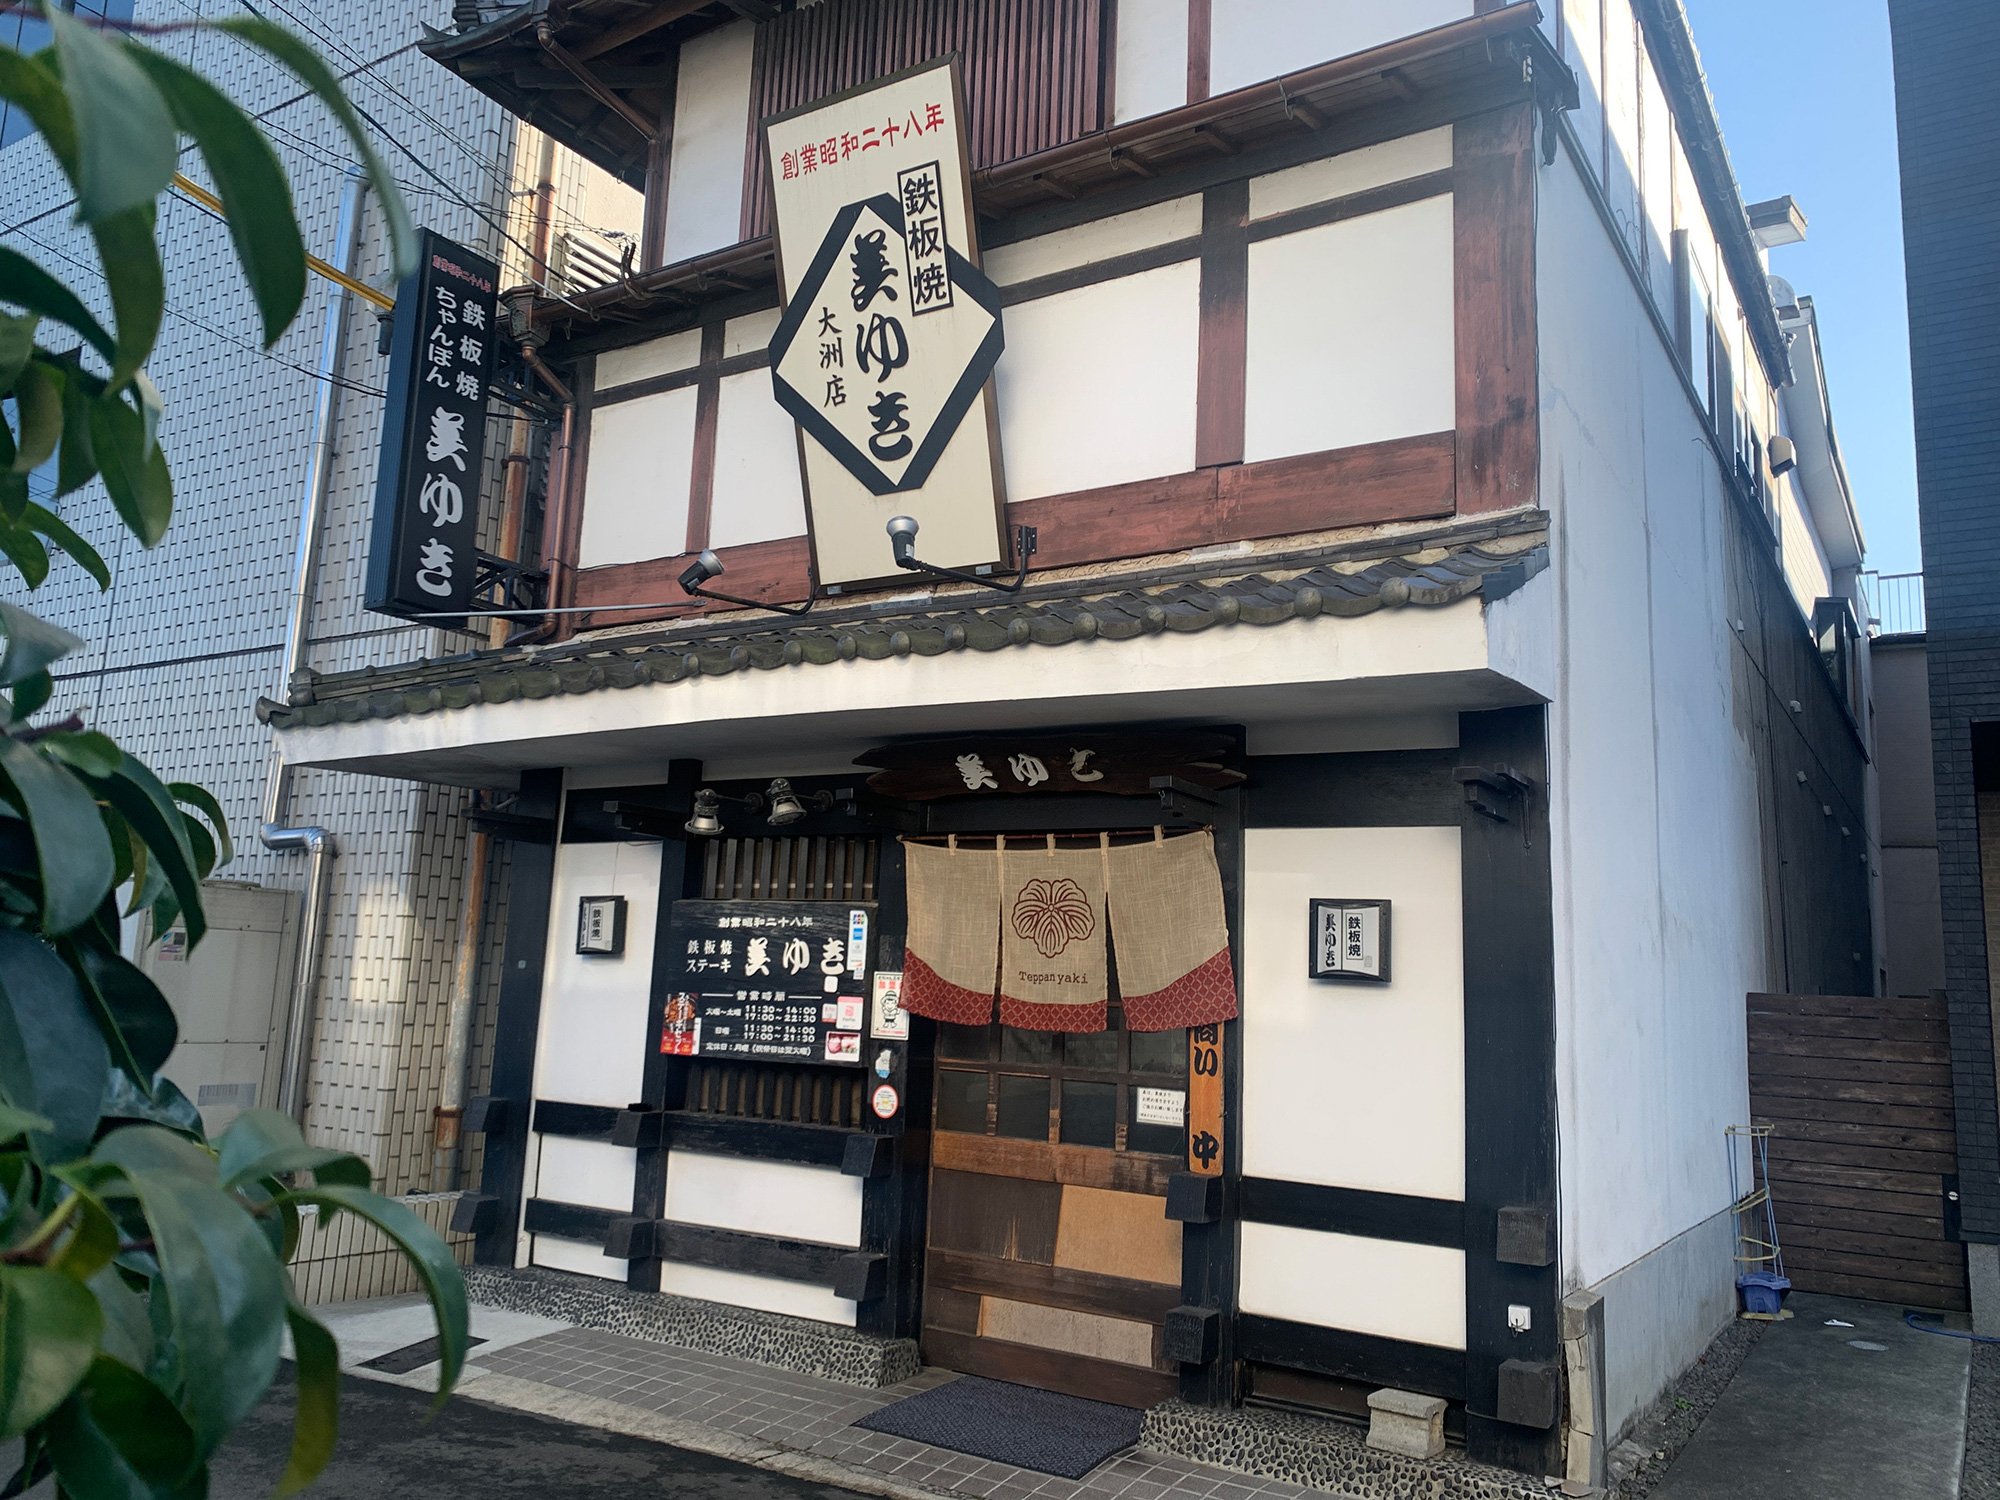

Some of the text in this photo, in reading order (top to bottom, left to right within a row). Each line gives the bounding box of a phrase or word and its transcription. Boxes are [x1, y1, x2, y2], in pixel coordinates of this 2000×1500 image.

[781, 103, 945, 181] 創業昭和二十八年
[902, 171, 948, 306] 鉄板焼
[425, 285, 458, 388] ちゃんぽん
[455, 299, 487, 402] 鉄板焼
[818, 306, 848, 409] 大洲店
[850, 228, 913, 462] 美ゆき
[415, 406, 469, 597] 美ゆき
[717, 916, 814, 929] 創業昭和二十八年
[1325, 912, 1337, 968] 美ゆき
[1348, 916, 1361, 957] 鉄板焼
[685, 958, 732, 973] ステーキ
[687, 939, 733, 955] 鉄板焼
[745, 936, 846, 977] 美ゆき
[736, 990, 786, 1001] 営業時間
[1019, 971, 1088, 985] Teppanyaki
[715, 1026, 730, 1035] 日曜
